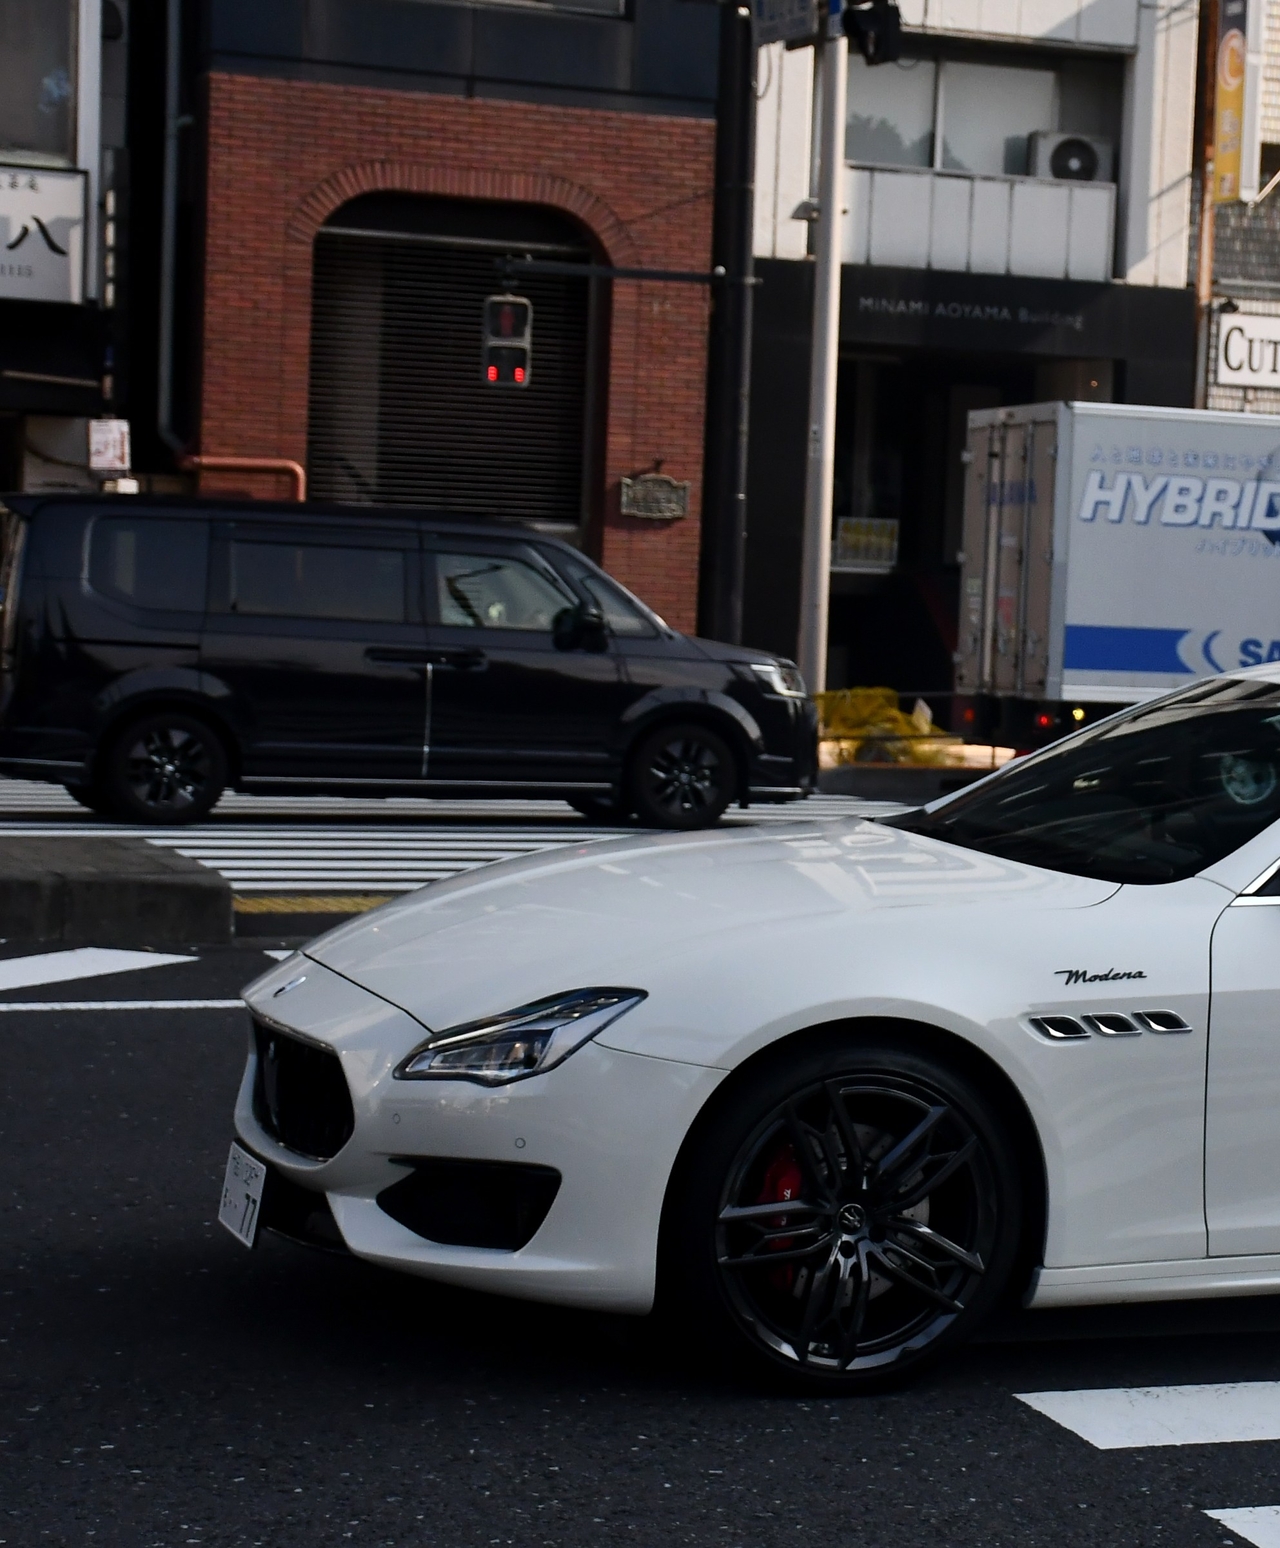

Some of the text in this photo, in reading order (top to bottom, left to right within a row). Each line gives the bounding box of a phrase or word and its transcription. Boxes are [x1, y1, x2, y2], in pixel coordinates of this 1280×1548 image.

[859, 296, 930, 316] MINAMI
[935, 301, 1012, 322] AOYAMA
[1054, 968, 1147, 985] Modena
